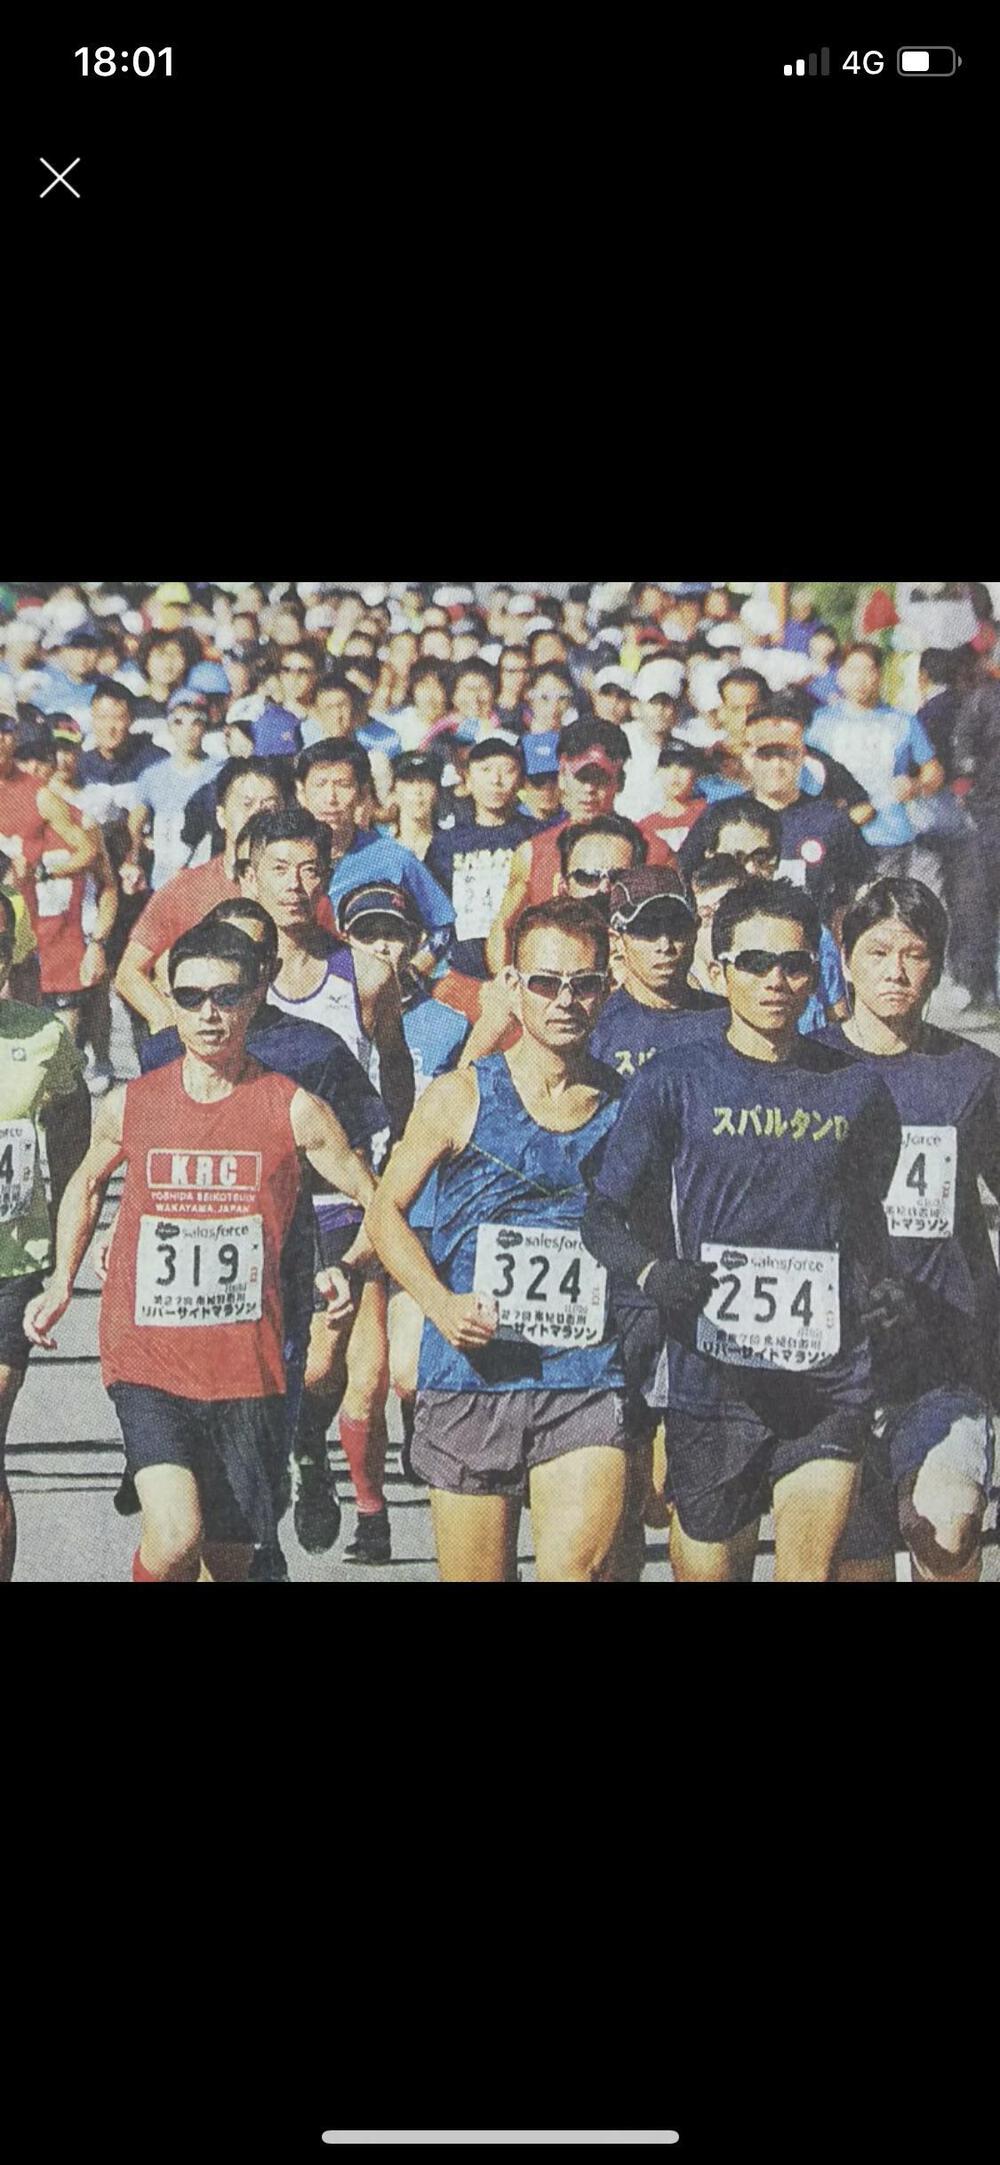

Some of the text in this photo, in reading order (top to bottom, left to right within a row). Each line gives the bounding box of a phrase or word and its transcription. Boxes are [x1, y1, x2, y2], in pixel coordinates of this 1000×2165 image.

[171, 1154, 238, 1187] KRC
[906, 1152, 928, 1197] 4
[183, 1225, 249, 1241] salesforce
[156, 1243, 239, 1287] 319
[492, 1253, 581, 1303] 324
[751, 1256, 824, 1274] salesforce
[717, 1273, 814, 1327] 254
